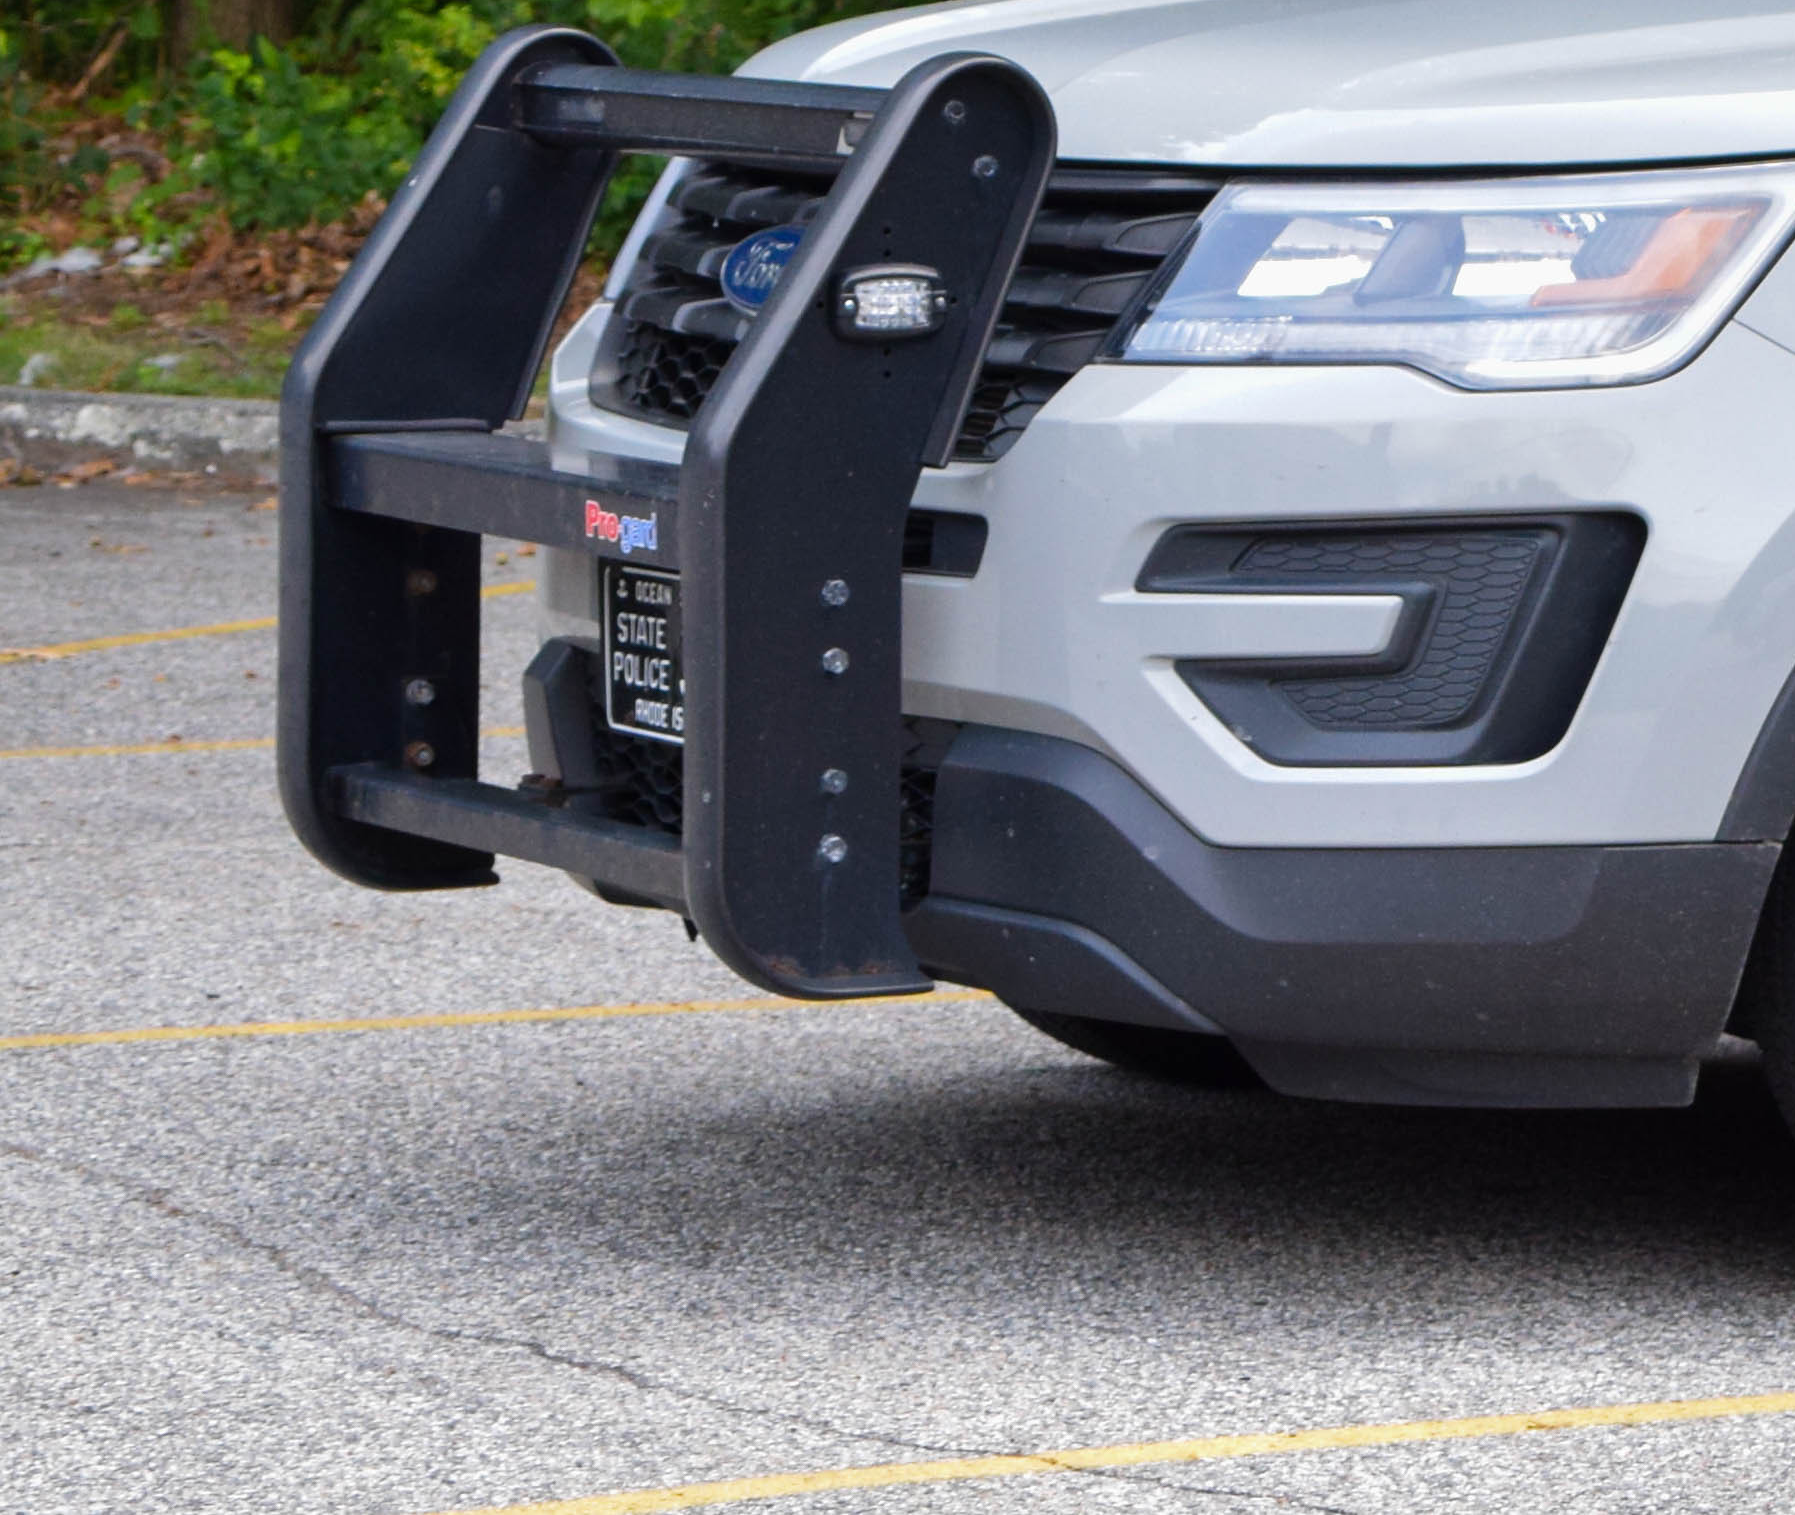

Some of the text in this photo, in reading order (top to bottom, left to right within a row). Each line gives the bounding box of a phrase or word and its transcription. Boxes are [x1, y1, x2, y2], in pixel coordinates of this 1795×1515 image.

[635, 580, 673, 605] OCEAN
[616, 612, 668, 650] STATE
[613, 651, 671, 692] POLICE
[634, 697, 669, 729] RHODE
